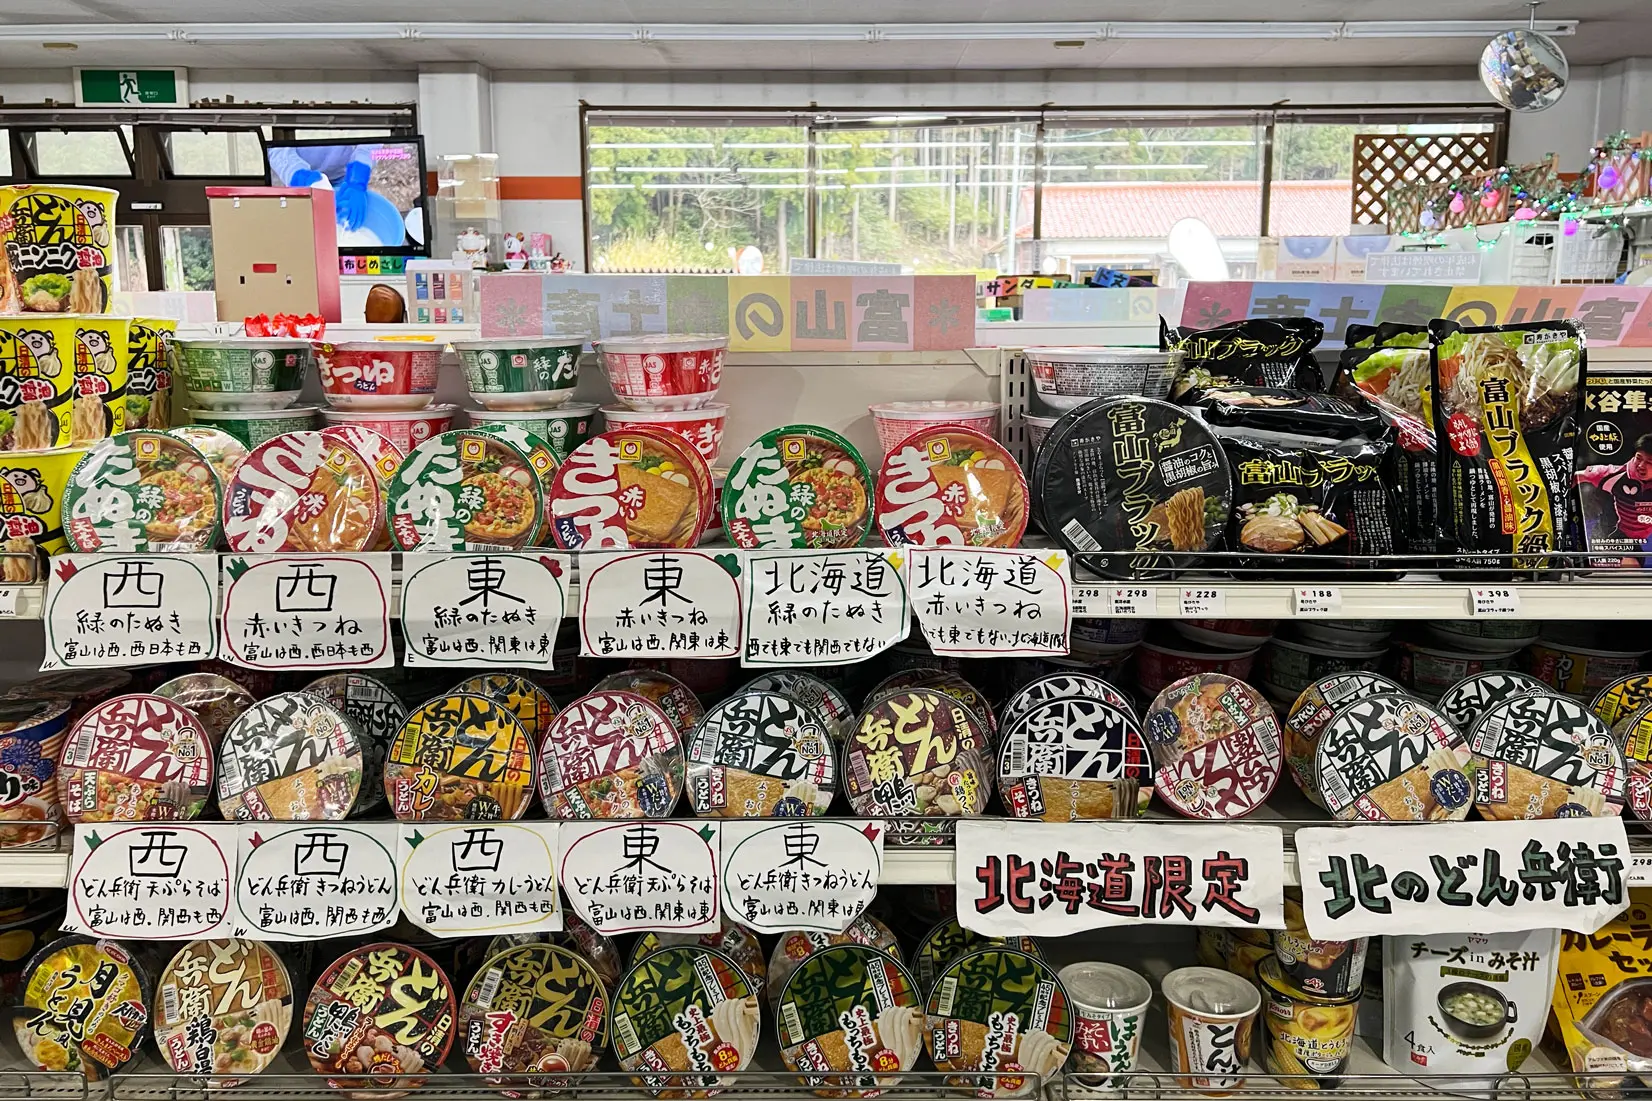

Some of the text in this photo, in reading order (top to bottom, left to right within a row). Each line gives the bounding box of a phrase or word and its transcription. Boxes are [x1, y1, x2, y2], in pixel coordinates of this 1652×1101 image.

[317, 355, 395, 387] きつね
[1596, 424, 1611, 432] 国産
[455, 484, 485, 523] 緑の
[618, 486, 646, 521] 赤い
[789, 483, 816, 520] 緑の
[942, 484, 967, 518] 赤い
[103, 561, 165, 610] 西
[275, 564, 338, 613] 西
[458, 556, 527, 608] 東
[639, 553, 694, 608] 東
[763, 553, 892, 598] 北海道
[917, 555, 1045, 596] 北海道
[925, 593, 1043, 621] 赤いきつね
[1312, 590, 1332, 598] 188
[1488, 590, 1510, 598] 398
[75, 611, 182, 637] 緑のたぬき
[243, 612, 364, 640] 赤いきつね
[433, 604, 538, 630] 緑のたぬき
[615, 606, 709, 629] 赤いきつね
[766, 600, 884, 627] 緑のたぬき
[888, 693, 957, 776] どん
[1065, 700, 1124, 780] どん
[70, 783, 82, 813] そば
[83, 771, 97, 810] 天ぷら
[397, 781, 410, 812] うどん
[697, 777, 710, 812] うどん
[711, 767, 726, 806] きつね
[1026, 777, 1043, 812] きつね
[1477, 769, 1489, 804] うどん
[1491, 760, 1506, 801] きつね
[1014, 791, 1030, 818] そば
[128, 830, 188, 878] 西
[294, 832, 350, 880] 西
[451, 828, 504, 872] 西
[613, 823, 672, 875] 東
[777, 822, 830, 871] 東
[1632, 858, 1652, 866] 298
[80, 879, 223, 898] どん兵衛 天ぷらそば
[246, 879, 392, 898] どん兵衛 きつねうどん
[412, 873, 486, 897] どん兵衛
[974, 850, 1261, 925] 北海道限定
[1318, 838, 1625, 920] 北のどん兵衛
[1410, 942, 1540, 971] チーズ in みそ汁
[207, 939, 263, 1016] どん
[529, 951, 593, 1038] どん
[374, 956, 448, 1046] どん
[308, 1005, 328, 1039] うどん
[467, 1021, 483, 1054] うどん
[947, 1020, 960, 1056] きつね
[171, 1036, 190, 1070] うどん
[935, 1030, 946, 1060] うどん
